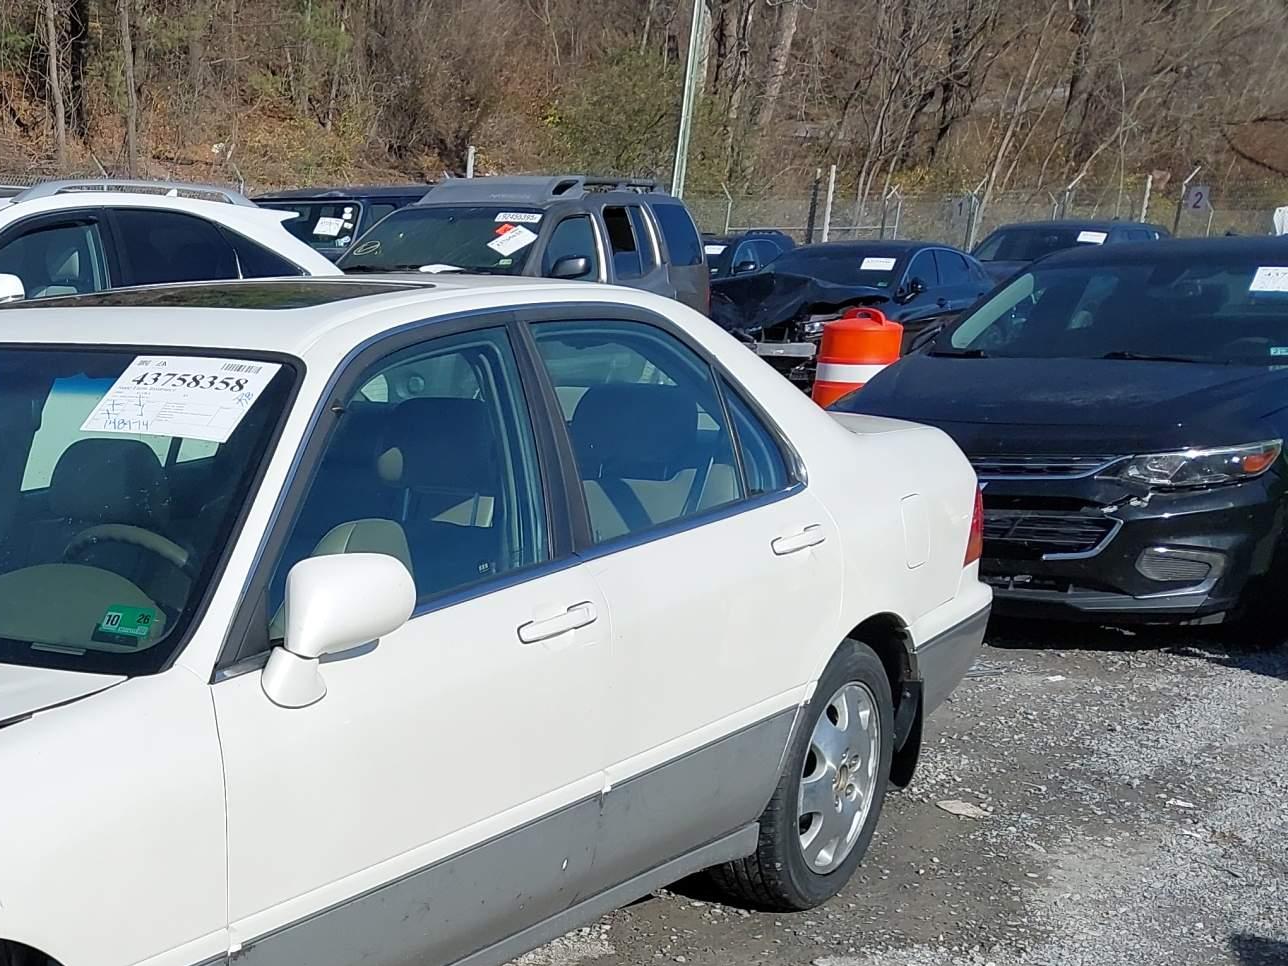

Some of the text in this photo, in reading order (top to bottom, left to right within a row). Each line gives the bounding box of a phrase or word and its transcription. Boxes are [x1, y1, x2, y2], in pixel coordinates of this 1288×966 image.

[1193, 191, 1203, 208] 2
[958, 202, 963, 216] 1
[132, 372, 249, 392] 43758358
[106, 614, 120, 626] 10
[137, 613, 151, 624] 26
